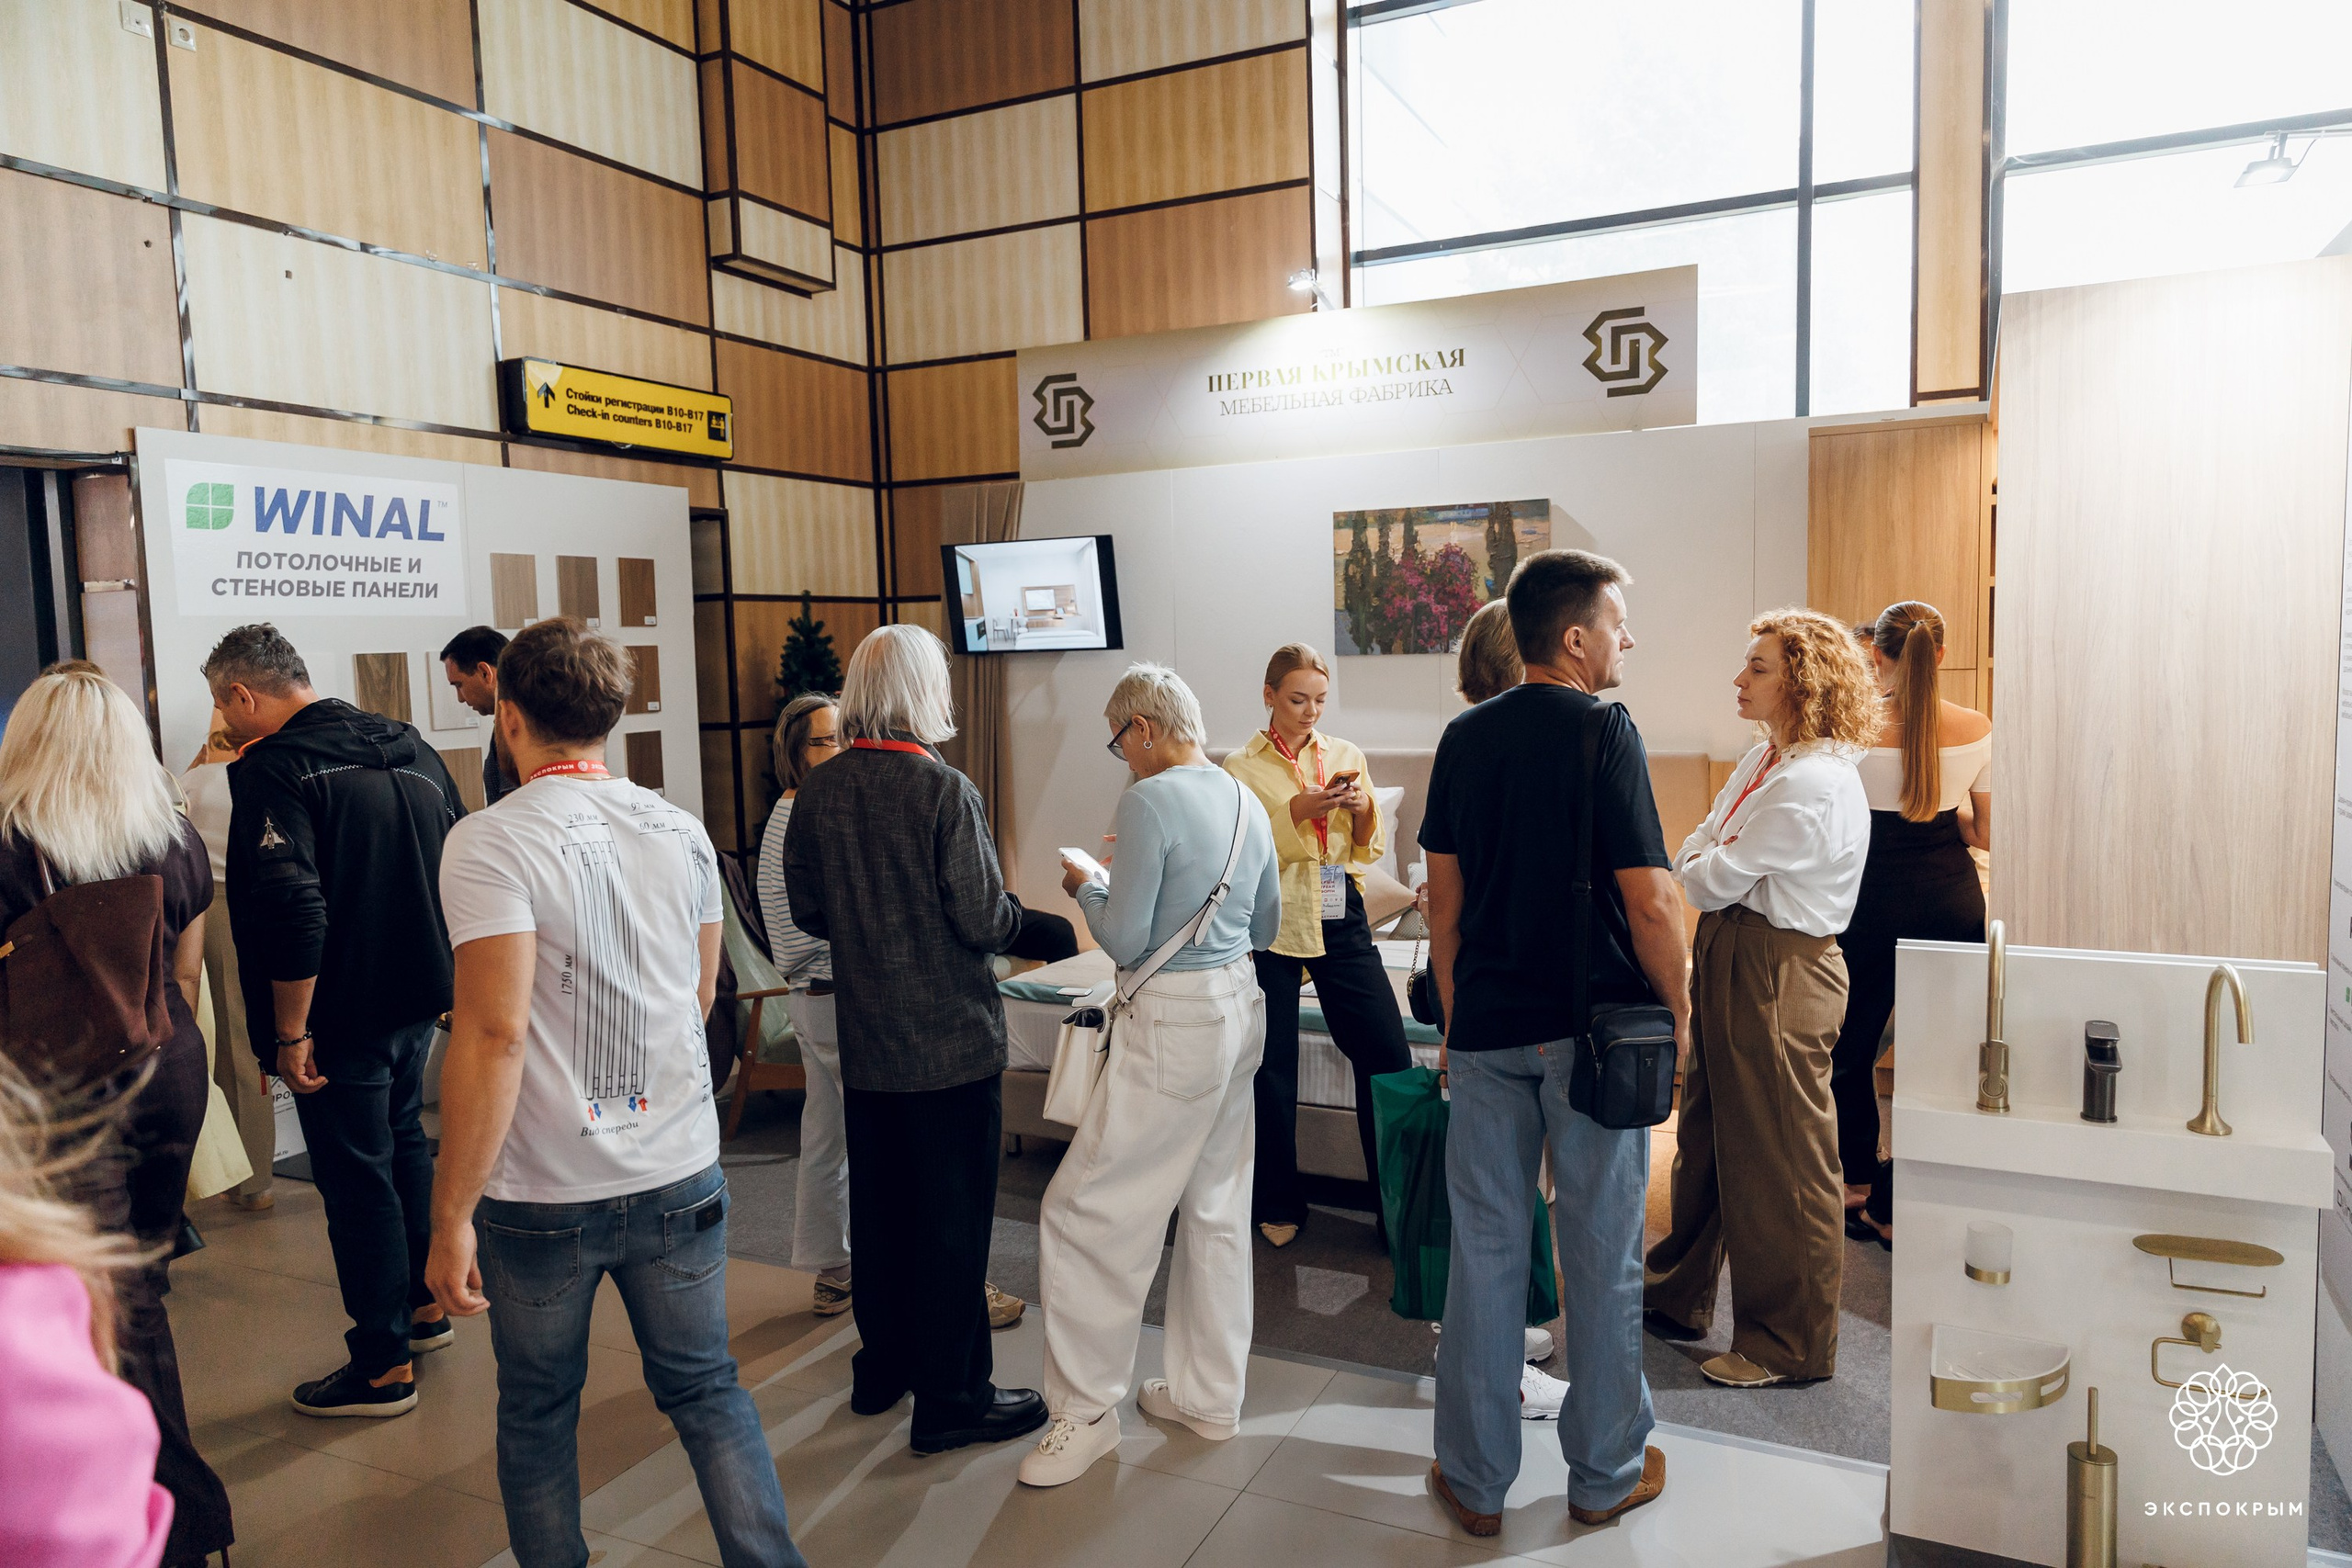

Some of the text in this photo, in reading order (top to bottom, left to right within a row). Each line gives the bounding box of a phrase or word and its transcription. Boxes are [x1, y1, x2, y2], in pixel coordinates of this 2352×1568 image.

[1206, 347, 1468, 393] ПЕРВАЯ КРЫМСКАЯ
[566, 388, 705, 422] Стойки регистрации B10-B17
[1219, 378, 1453, 416] МЕБЕЛЬНАЯ ФАБРИКА
[567, 403, 694, 434] Check-in counters B10-B17
[254, 486, 445, 542] WINAL
[236, 550, 422, 574] ПОТОЛОЧНЫЕ И
[211, 577, 439, 599] СТЕНОВЫЕ ПАНЕЛИ
[530, 763, 574, 781] ЭКСПОКРЫМ
[561, 971, 572, 995] 1750
[580, 1120, 639, 1137] Вид спереди
